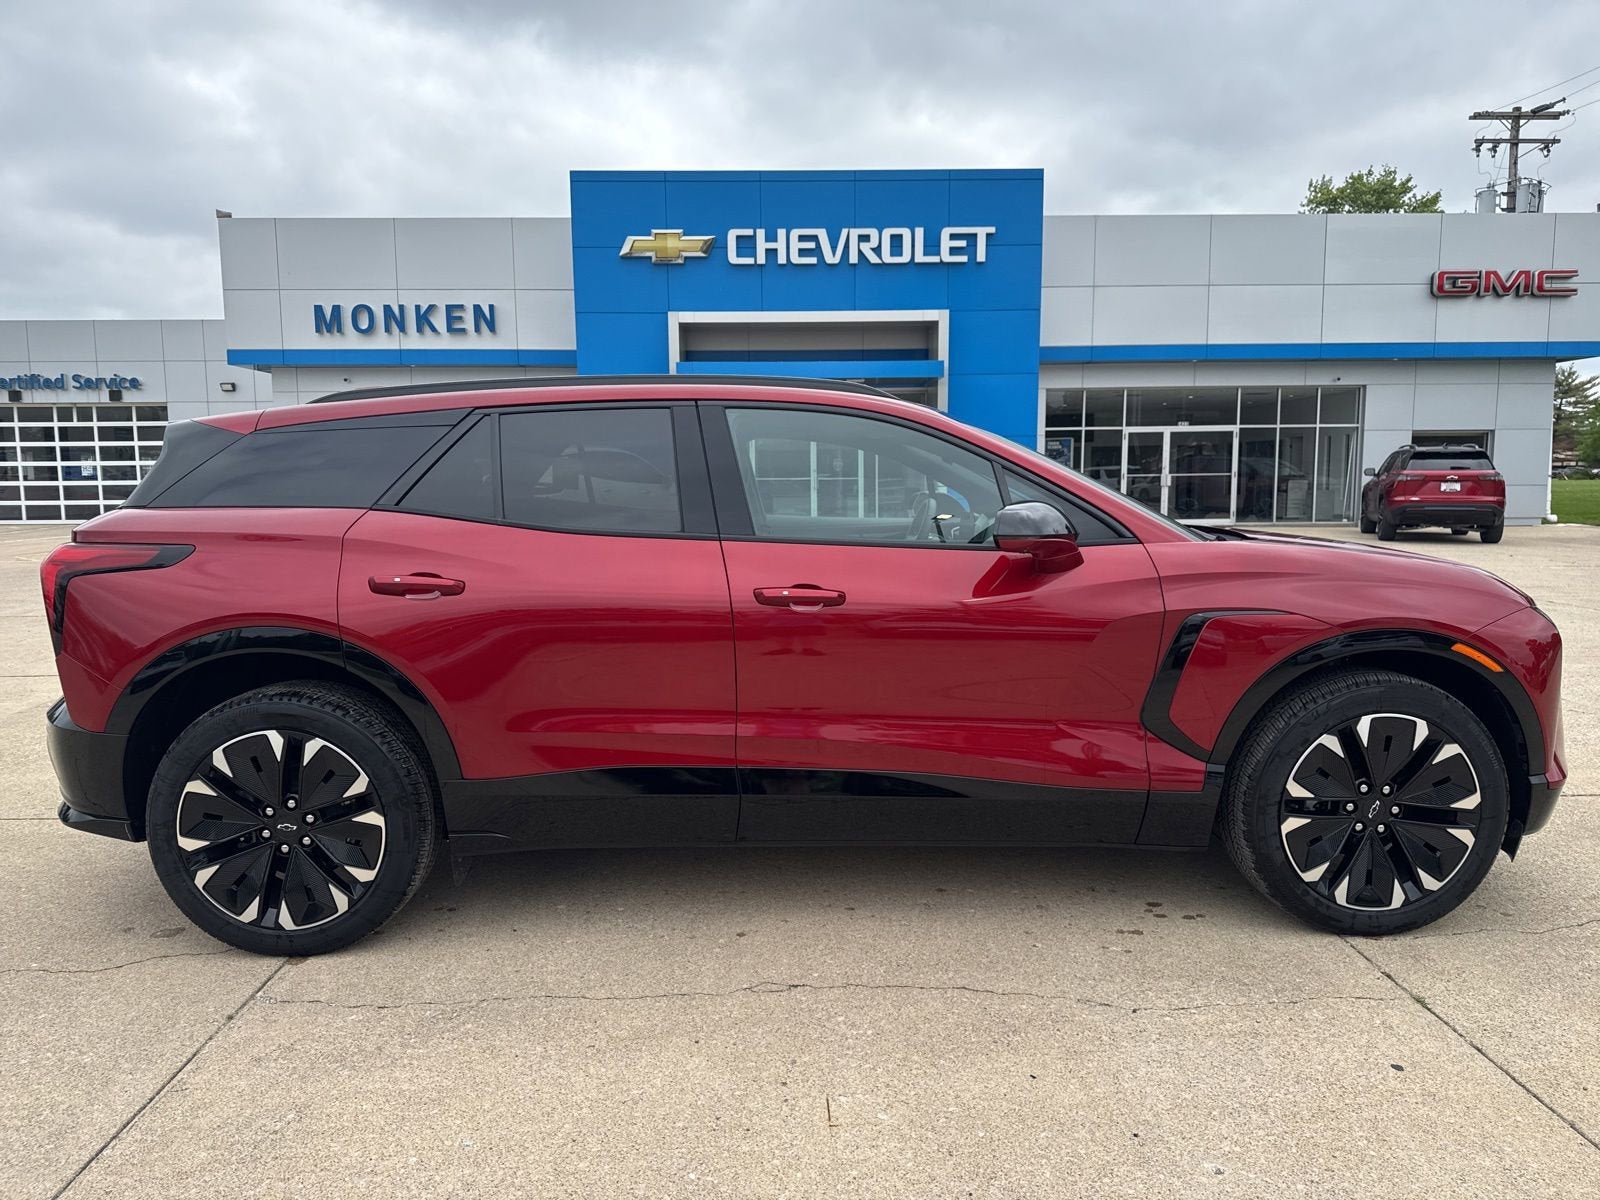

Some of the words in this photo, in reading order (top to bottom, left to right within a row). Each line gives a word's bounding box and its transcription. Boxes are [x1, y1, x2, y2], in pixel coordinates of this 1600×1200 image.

[727, 226, 996, 264] CHEVROLET
[1431, 269, 1579, 297] GMC
[313, 303, 497, 335] MONKEN
[71, 373, 140, 391] Service
